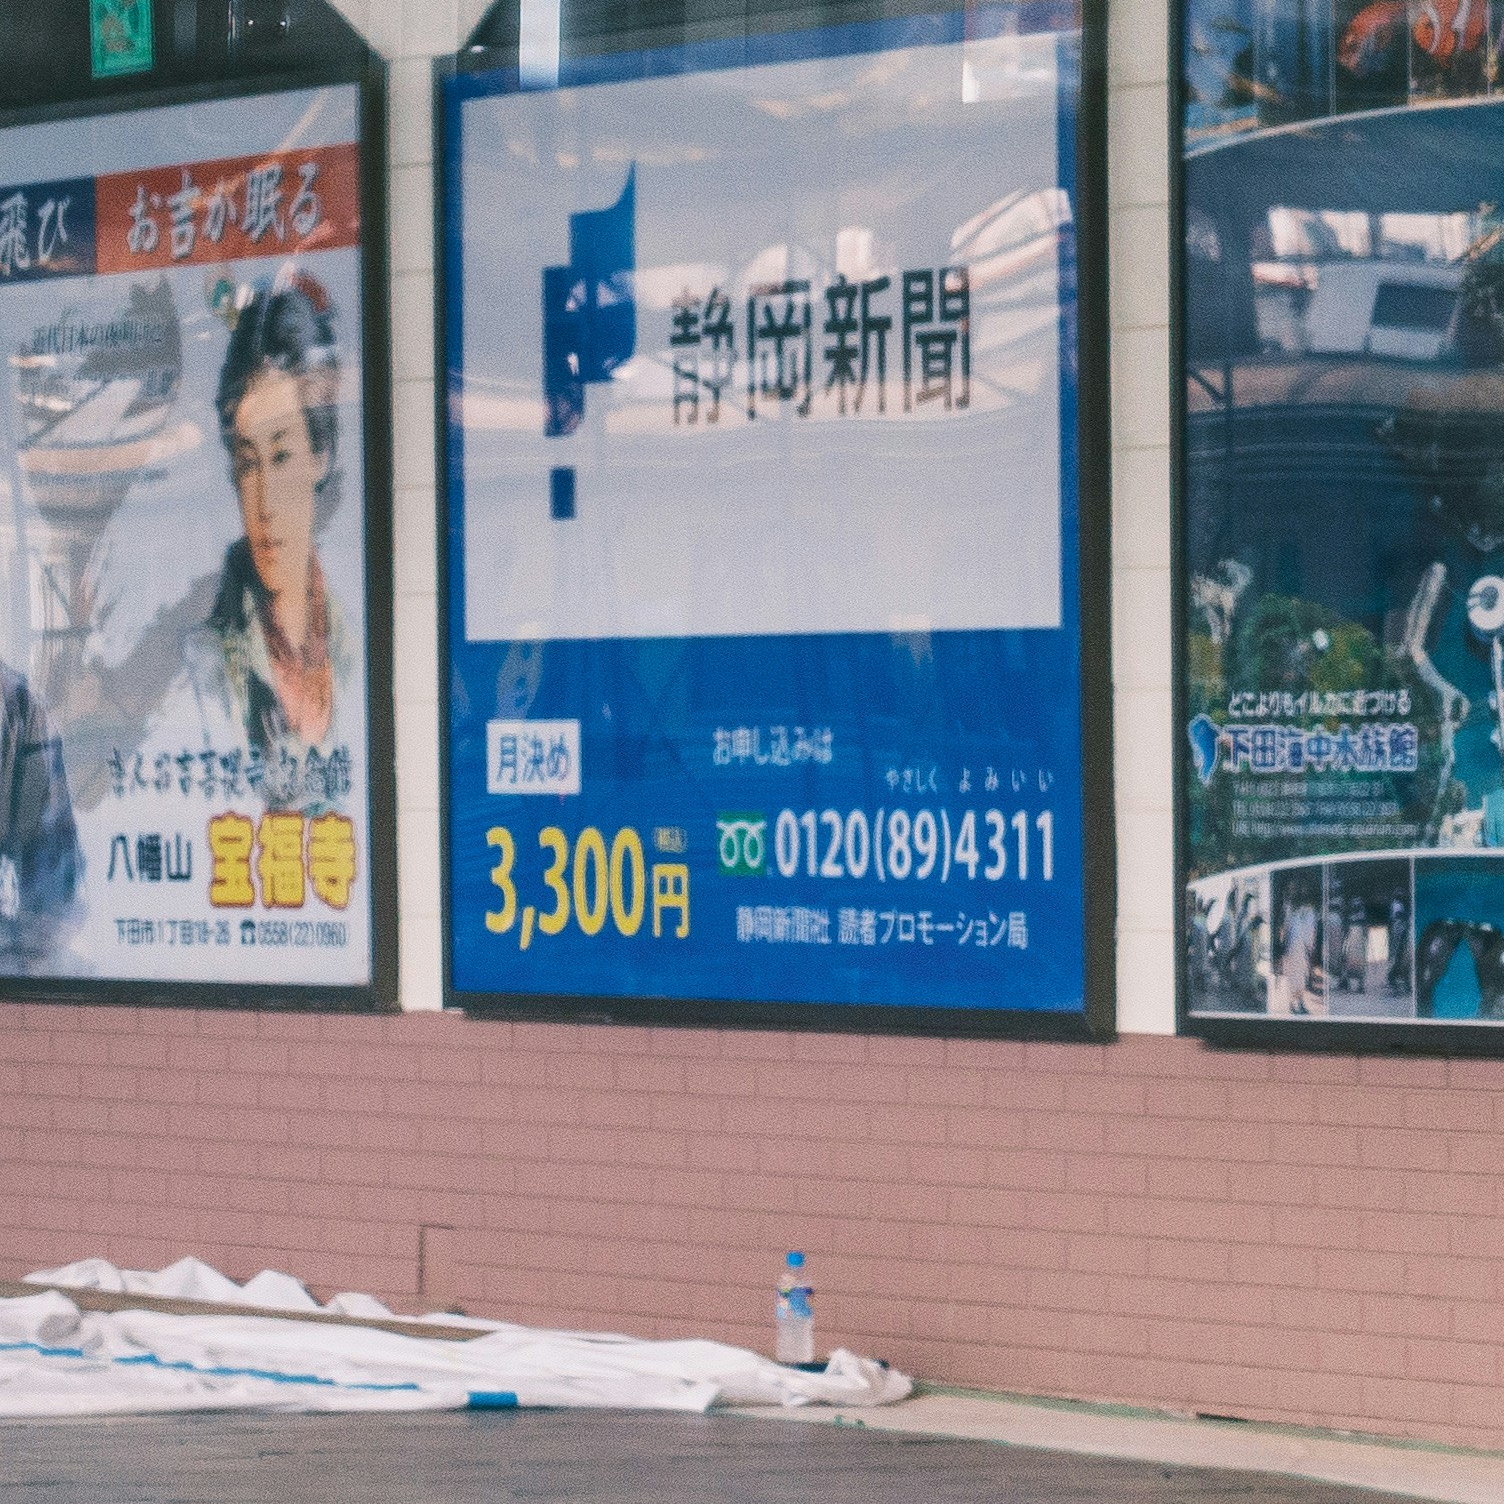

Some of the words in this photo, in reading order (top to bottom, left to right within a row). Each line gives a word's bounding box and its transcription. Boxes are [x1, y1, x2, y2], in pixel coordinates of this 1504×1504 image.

[669, 262, 972, 427] 静岡新聞
[495, 731, 573, 785] 月決め
[711, 725, 834, 767] お申し込みは
[1223, 724, 1419, 773] 下田海中水族館
[106, 831, 193, 884] 八幡山
[773, 807, 1056, 884] 0120(89)4311
[837, 906, 1029, 951] 読者プロモーション局
